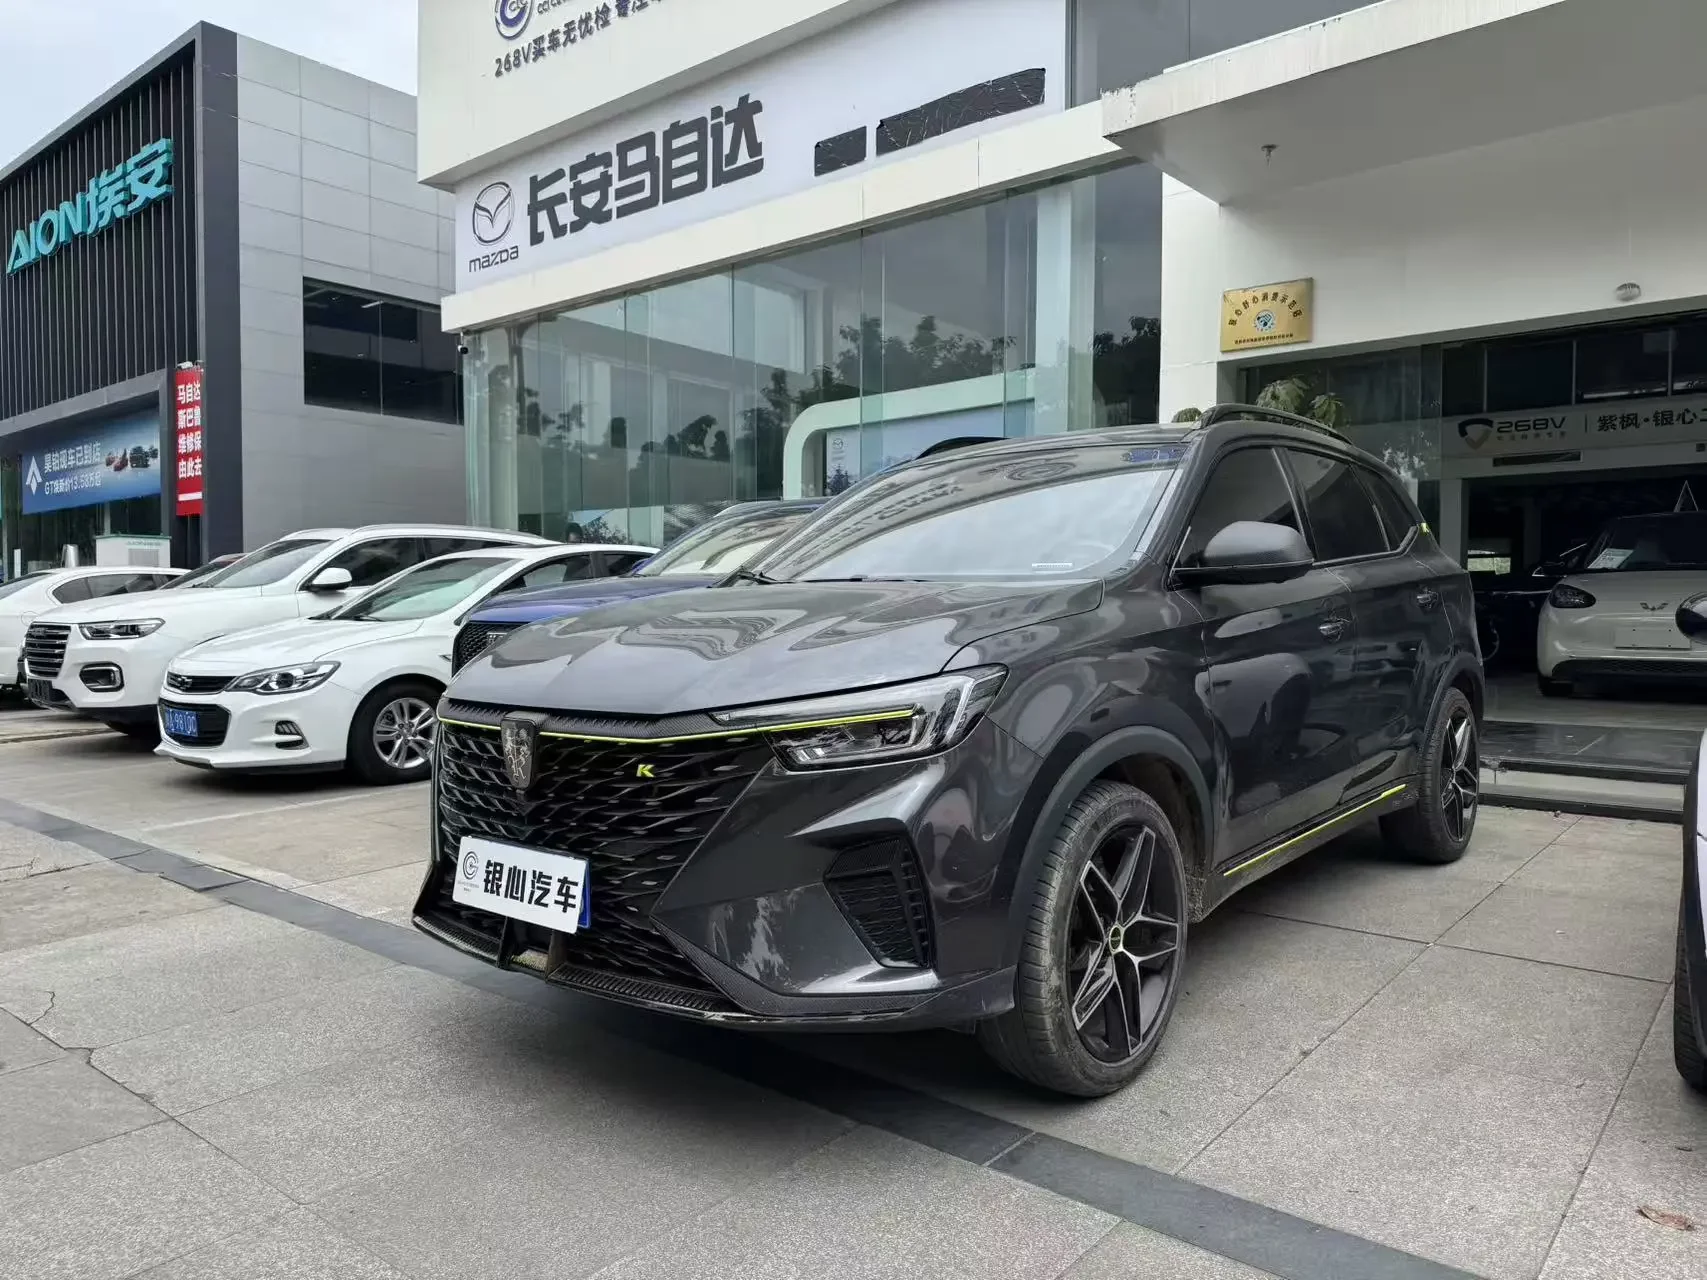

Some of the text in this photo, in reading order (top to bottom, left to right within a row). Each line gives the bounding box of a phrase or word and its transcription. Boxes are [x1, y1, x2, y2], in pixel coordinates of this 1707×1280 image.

[527, 93, 764, 246] 长安马自达
[468, 245, 519, 273] mazda
[177, 381, 201, 404] 马自达
[177, 405, 201, 429] 斯巴鲁
[1496, 416, 1567, 433] 268V
[636, 764, 655, 778] K
[483, 859, 579, 914] 银心汽车
